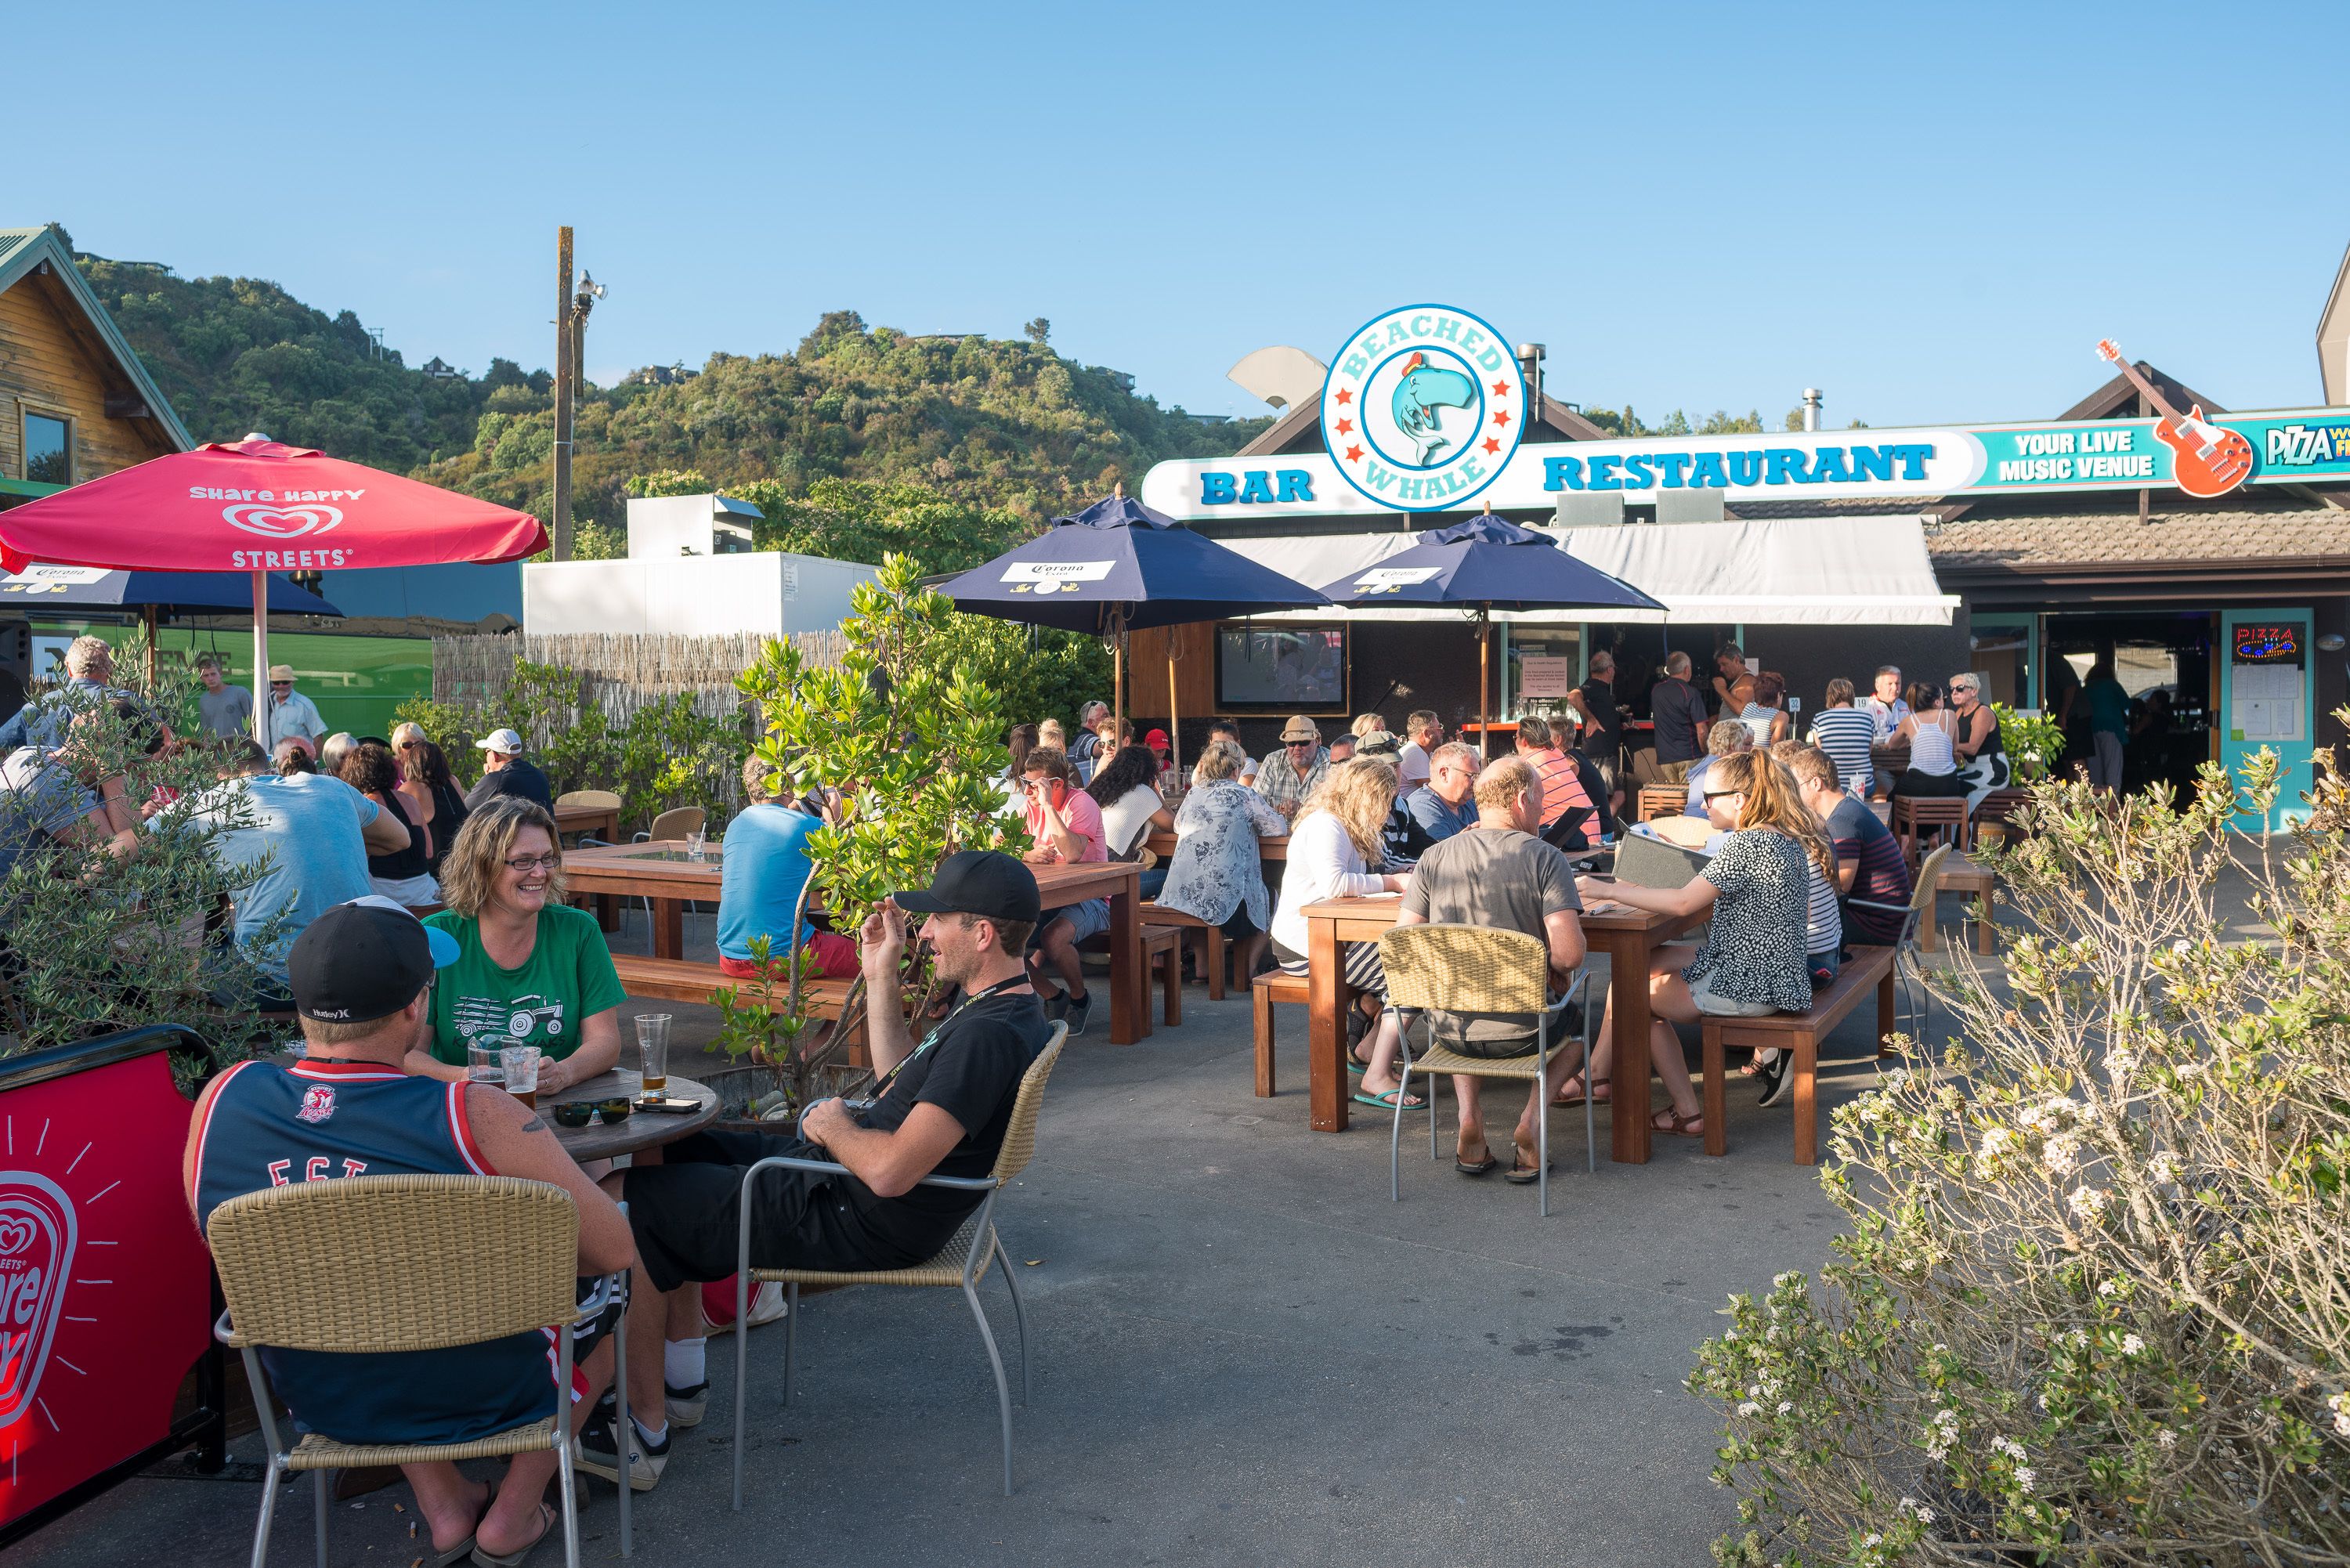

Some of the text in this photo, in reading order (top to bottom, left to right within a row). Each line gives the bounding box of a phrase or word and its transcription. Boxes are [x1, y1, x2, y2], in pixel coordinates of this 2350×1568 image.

[1342, 316, 1502, 381] BEACHED
[2015, 431, 2131, 455] YOUR LIVE
[2329, 428, 2350, 439] W
[2266, 425, 2334, 465] PIZZA
[1543, 444, 1932, 491] RESTAURANT
[2000, 456, 2153, 481] MUSIC VENUE
[1201, 470, 1314, 504] BAR
[1365, 456, 1487, 500] WHALE
[1031, 564, 1084, 573] Corona
[2237, 628, 2294, 641] PIZZA
[1791, 699, 1799, 709] 32
[1857, 699, 1867, 708] 19
[313, 1009, 338, 1019] Hurley
[524, 1035, 566, 1050] YAKS
